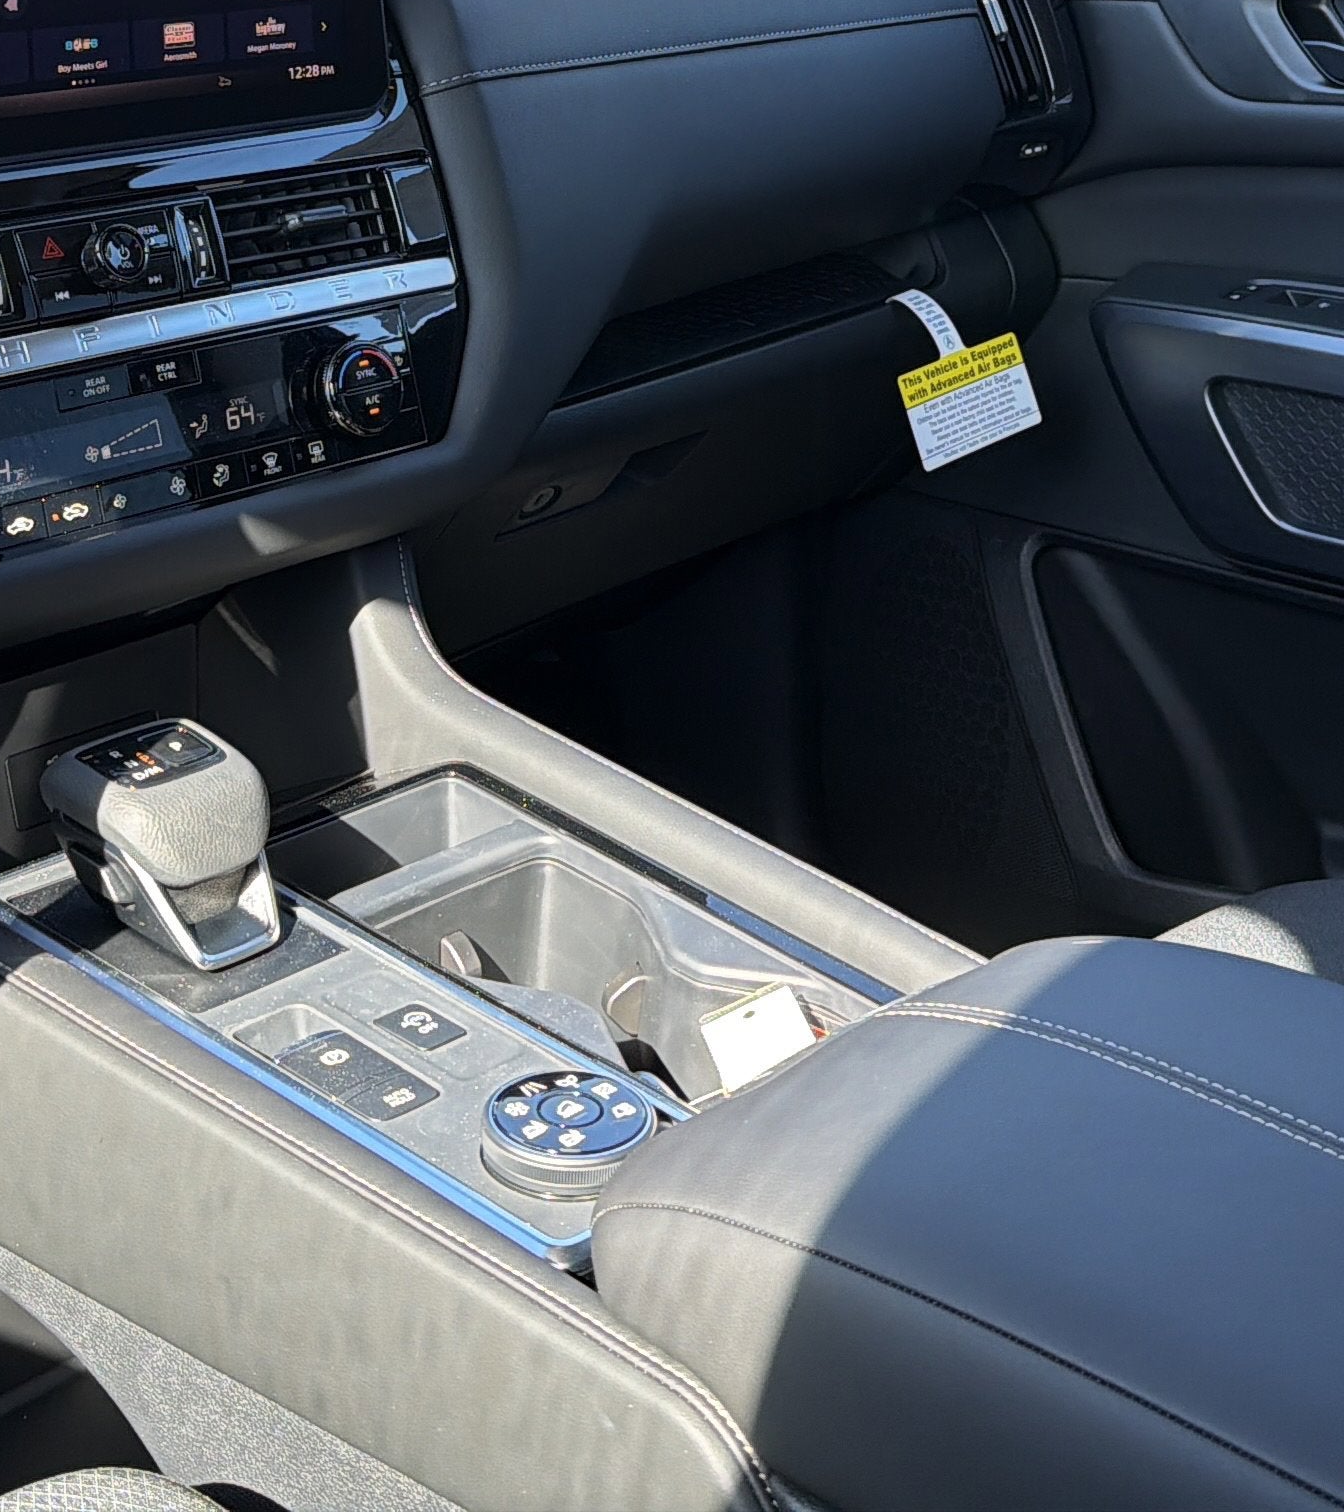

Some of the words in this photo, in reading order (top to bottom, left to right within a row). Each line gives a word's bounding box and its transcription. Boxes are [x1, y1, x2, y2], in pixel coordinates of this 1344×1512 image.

[247, 44, 269, 54] Megan
[164, 51, 198, 62] Aerosmith
[58, 63, 71, 73] Boy
[72, 62, 95, 71] Meets
[288, 64, 320, 80] 12:28
[321, 65, 335, 75] PM
[156, 361, 177, 373] REAR
[901, 374, 922, 388] This
[923, 360, 958, 379] Vehicle
[958, 355, 969, 366] is
[970, 337, 1013, 361] Equipped
[157, 371, 178, 382] CTRL
[356, 367, 377, 381] SYNC
[907, 386, 928, 402] with
[930, 366, 975, 393] Advanced
[977, 361, 990, 374] Air
[992, 352, 1016, 368] Bags
[85, 376, 106, 387] REAR
[923, 401, 939, 413] Even
[953, 382, 983, 400] Advanced
[993, 372, 1010, 384] Bags
[229, 395, 248, 406] SYNC
[365, 394, 381, 405] A/C
[225, 403, 255, 431] 64
